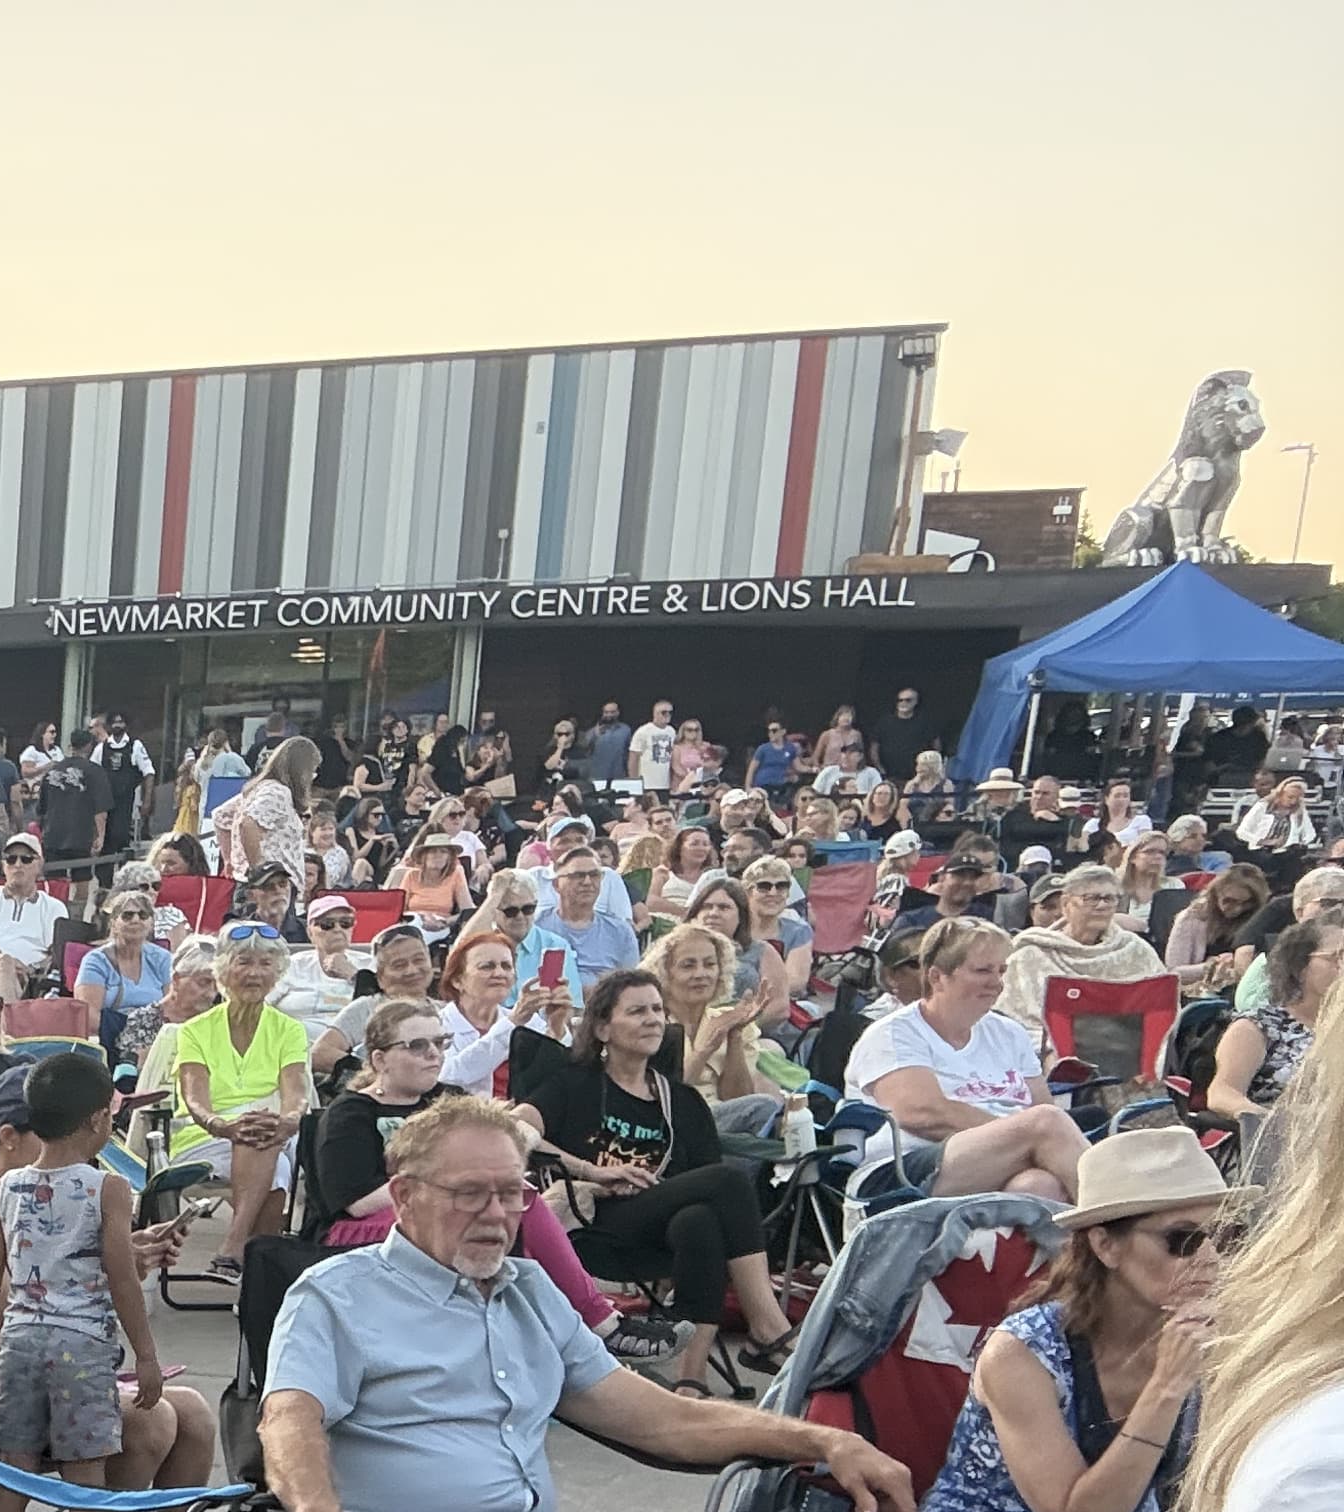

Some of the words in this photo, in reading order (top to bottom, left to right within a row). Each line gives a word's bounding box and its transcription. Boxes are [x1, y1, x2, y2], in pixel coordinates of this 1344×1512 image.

[53, 599, 269, 636] NEWMARKET
[276, 590, 501, 627] COMMUNITY
[510, 585, 651, 618] CENTRE
[662, 583, 688, 613] &
[701, 579, 812, 612] LIONS
[823, 576, 916, 608] HALL
